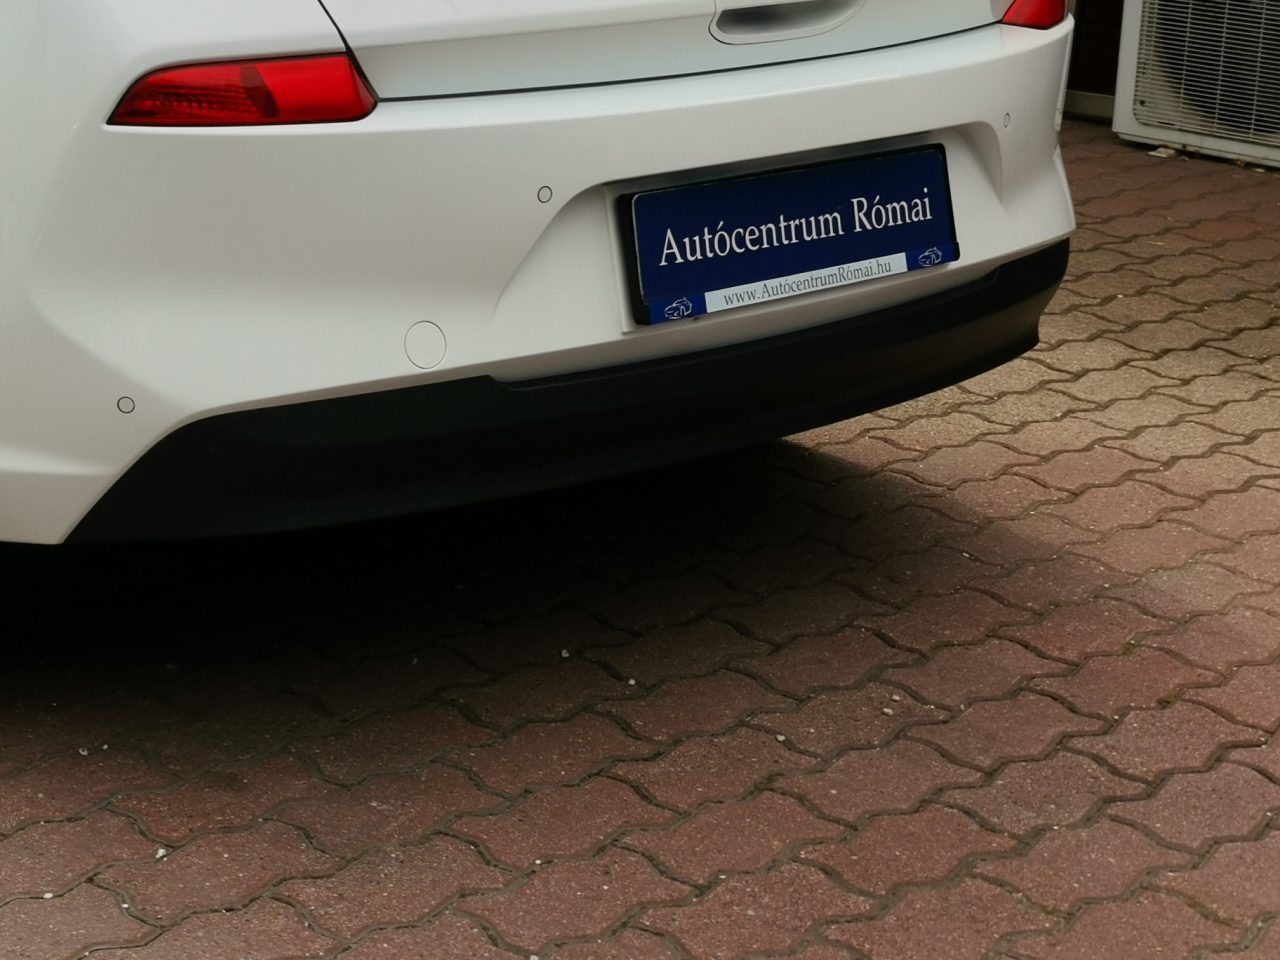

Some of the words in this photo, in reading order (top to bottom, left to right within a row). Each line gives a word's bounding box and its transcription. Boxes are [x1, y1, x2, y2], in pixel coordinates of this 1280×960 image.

[658, 210, 845, 267] Autócentrum
[851, 187, 933, 233] Római
[723, 260, 893, 307] www.AutócentrumRómai.hu
